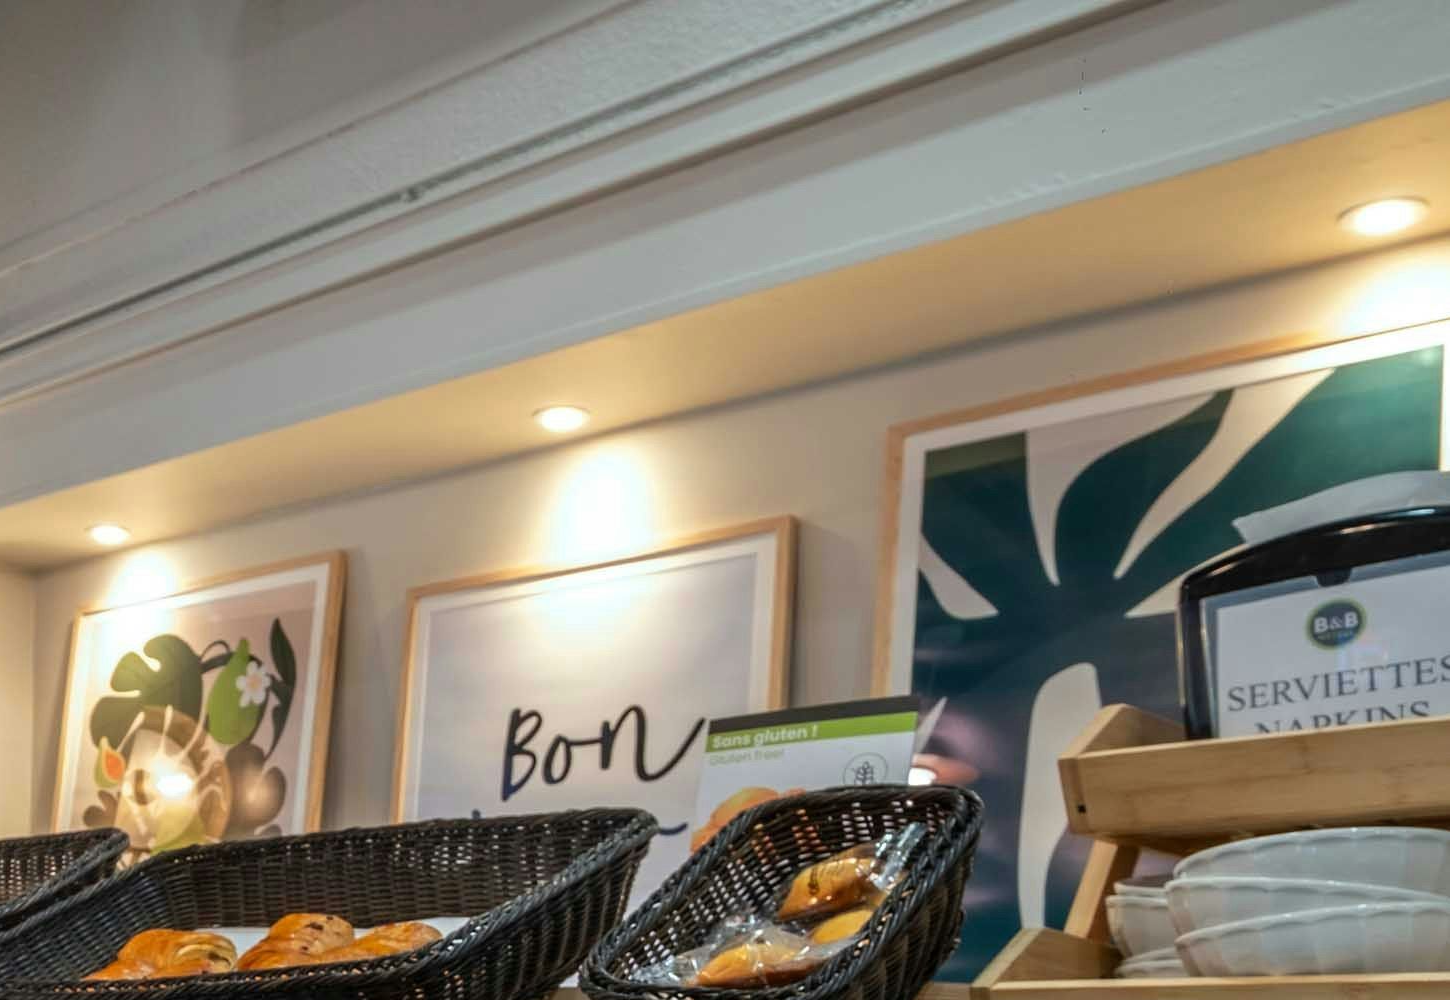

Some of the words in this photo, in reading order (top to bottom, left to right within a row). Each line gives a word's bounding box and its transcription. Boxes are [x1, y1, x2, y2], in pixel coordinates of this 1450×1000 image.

[1313, 611, 1359, 634] B&B
[1227, 654, 1450, 712] SERVIETTES
[502, 705, 706, 801] Bon
[712, 732, 750, 749] Sans
[754, 727, 808, 747] gluten
